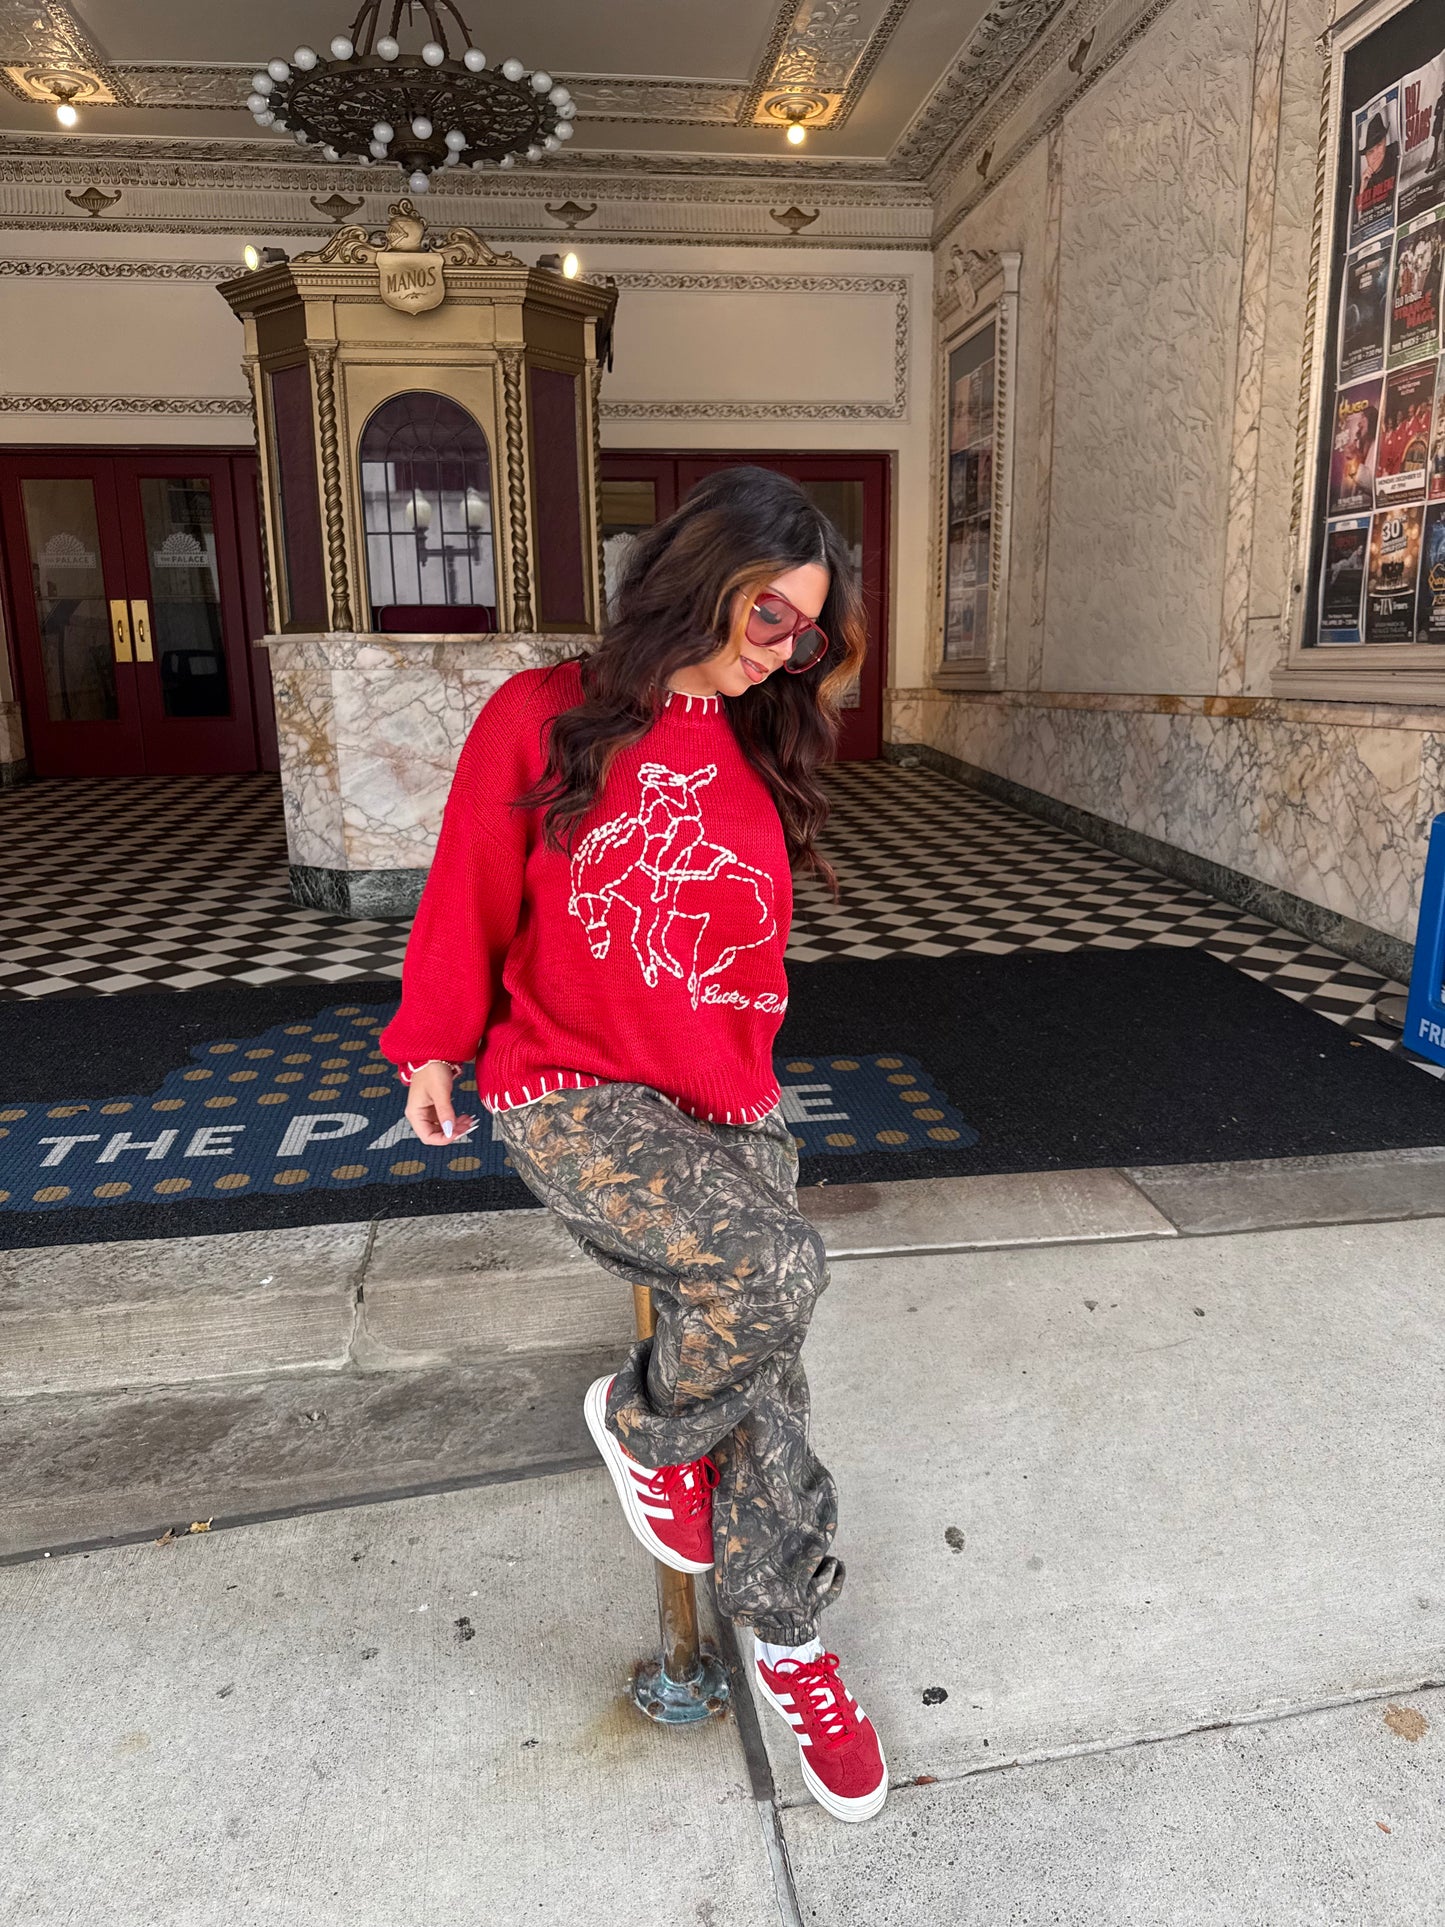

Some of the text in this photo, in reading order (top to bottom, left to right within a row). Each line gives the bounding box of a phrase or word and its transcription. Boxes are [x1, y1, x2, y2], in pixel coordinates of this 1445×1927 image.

[387, 266, 437, 294] MANOS
[700, 984, 751, 1010] Lucky
[38, 1125, 247, 1168] THE
